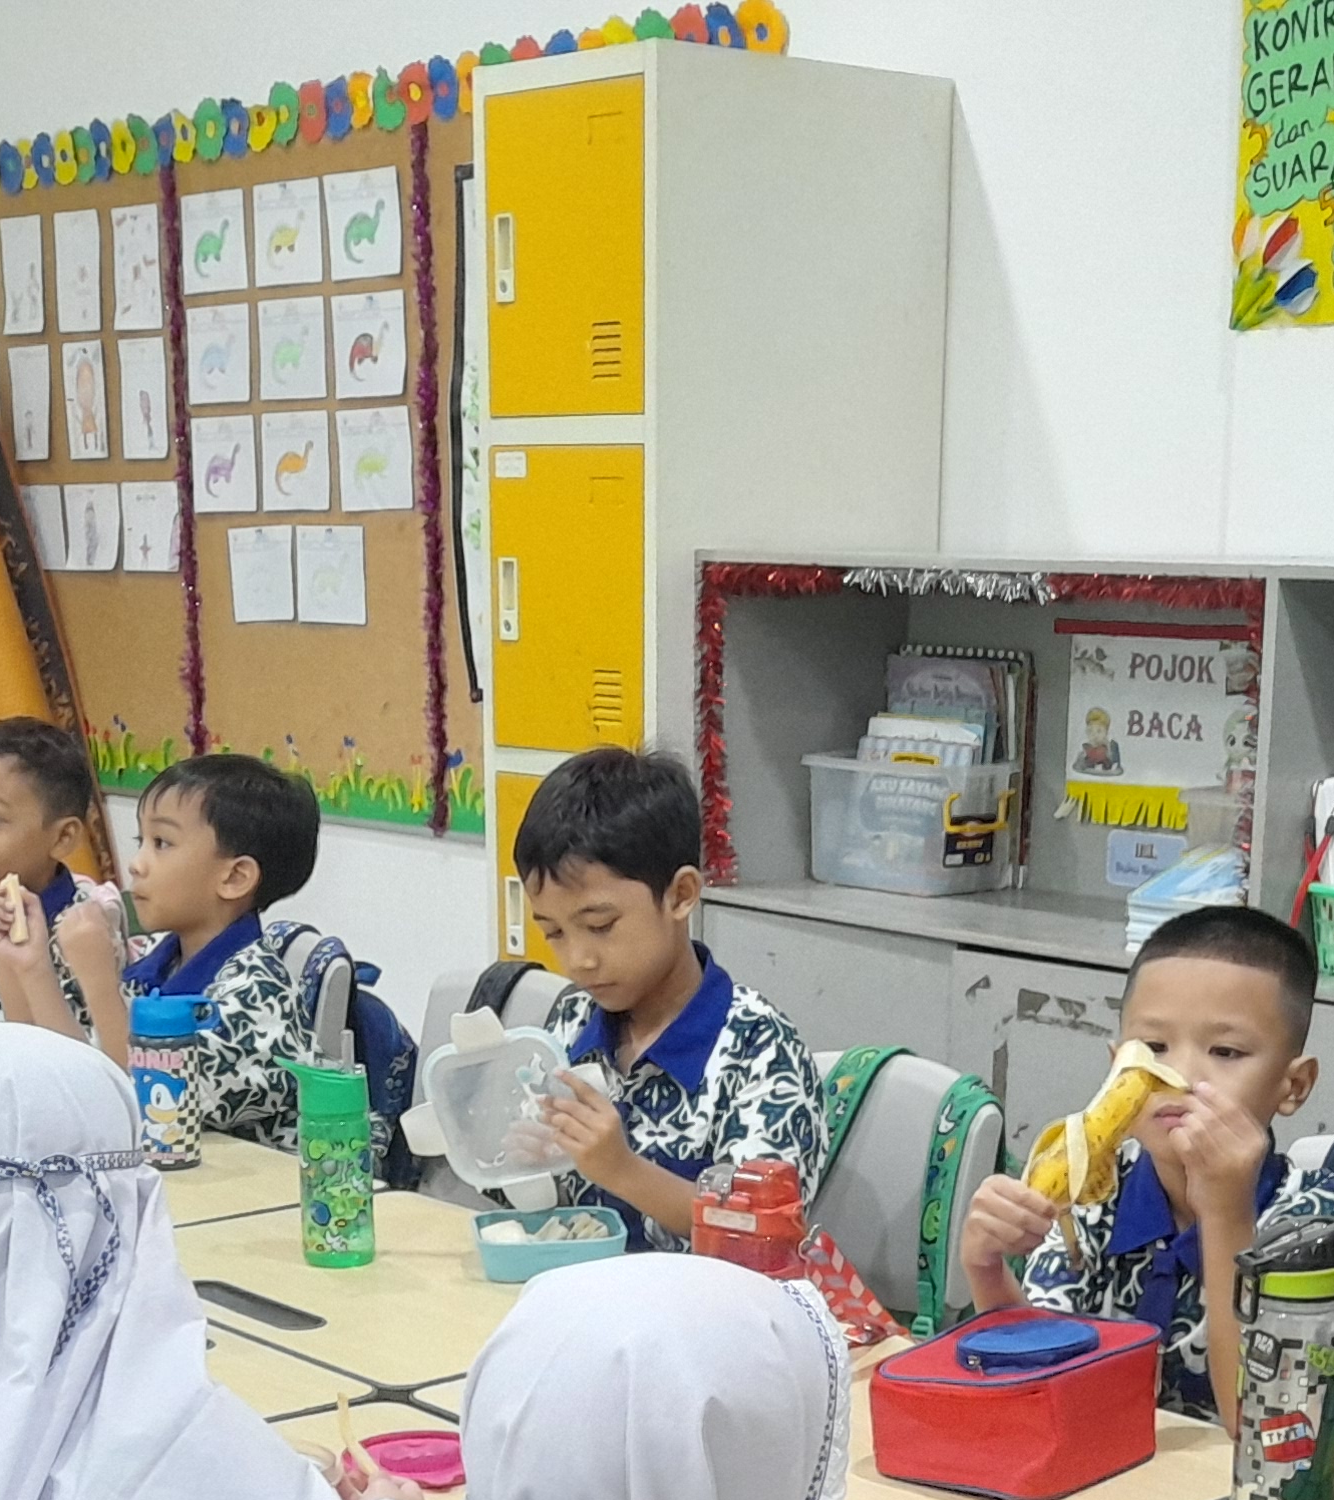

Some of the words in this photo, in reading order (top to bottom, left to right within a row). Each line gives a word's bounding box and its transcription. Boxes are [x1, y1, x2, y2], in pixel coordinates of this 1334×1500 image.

[1274, 118, 1314, 148] dan
[1129, 652, 1216, 683] POJOK
[1127, 709, 1204, 742] BACA
